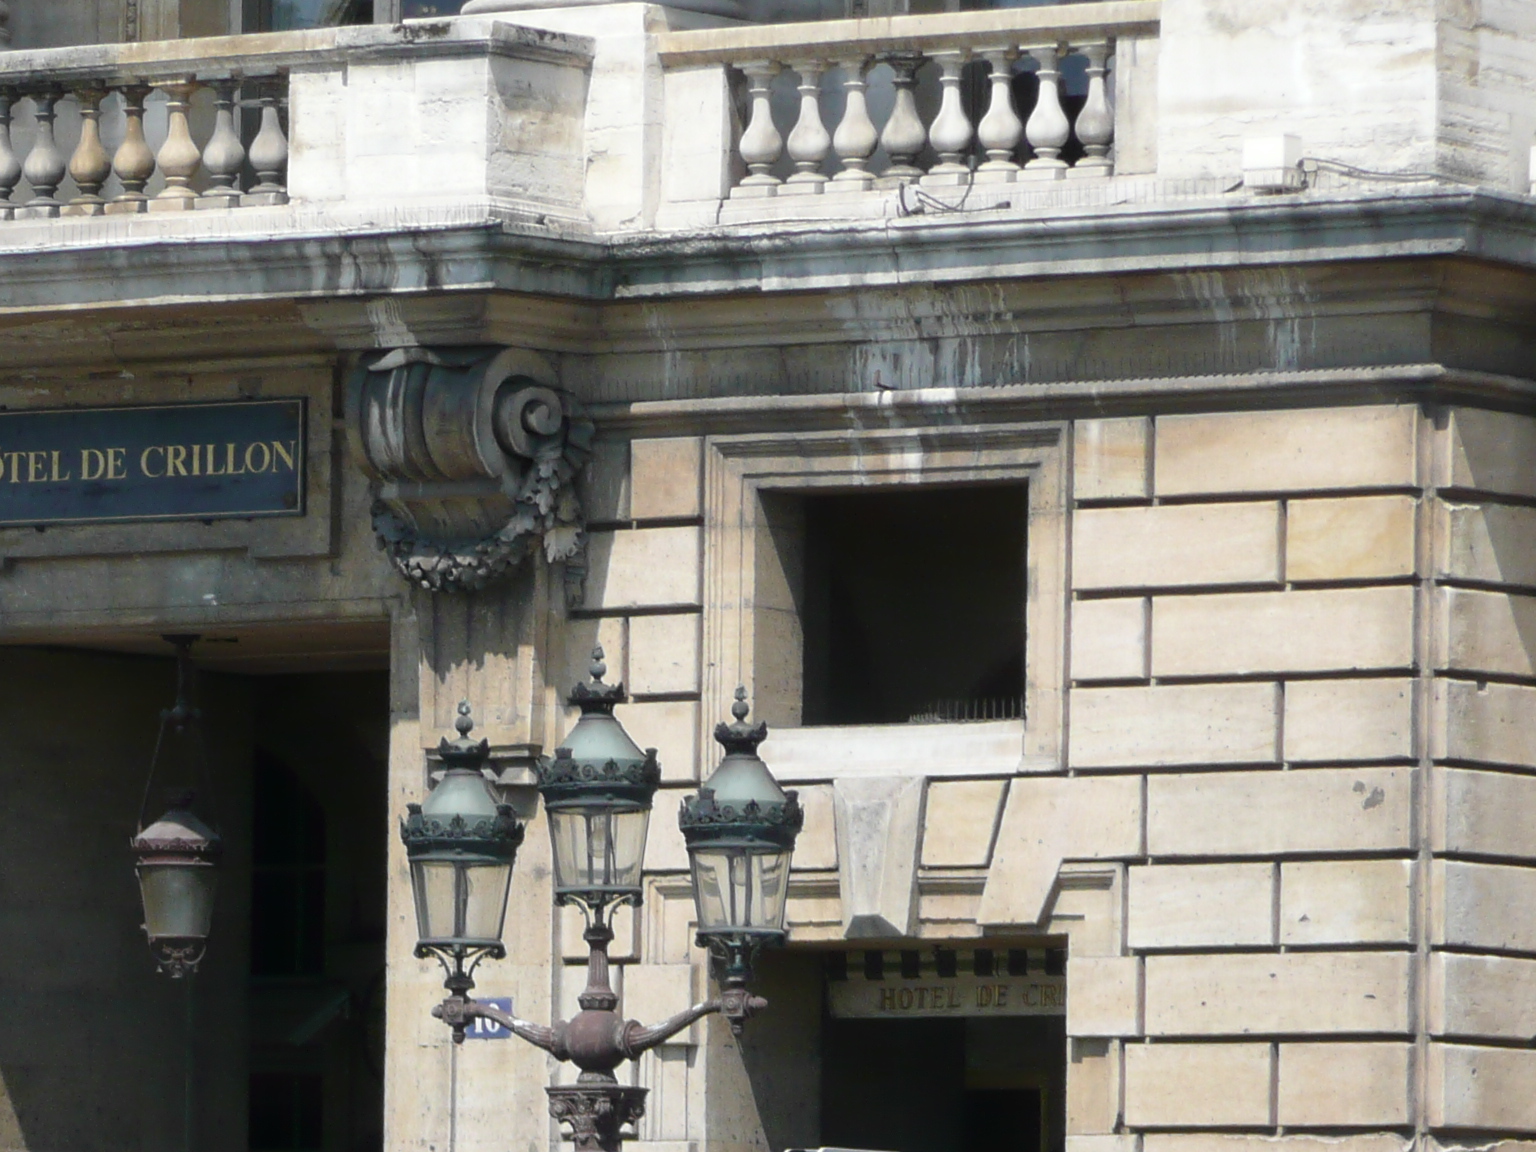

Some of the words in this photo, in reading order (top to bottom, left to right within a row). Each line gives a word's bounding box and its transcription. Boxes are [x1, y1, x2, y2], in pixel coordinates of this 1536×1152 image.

[81, 447, 128, 481] DE
[140, 439, 297, 478] CRILLON
[879, 985, 961, 1010] HOTEL
[975, 983, 1009, 1008] DE
